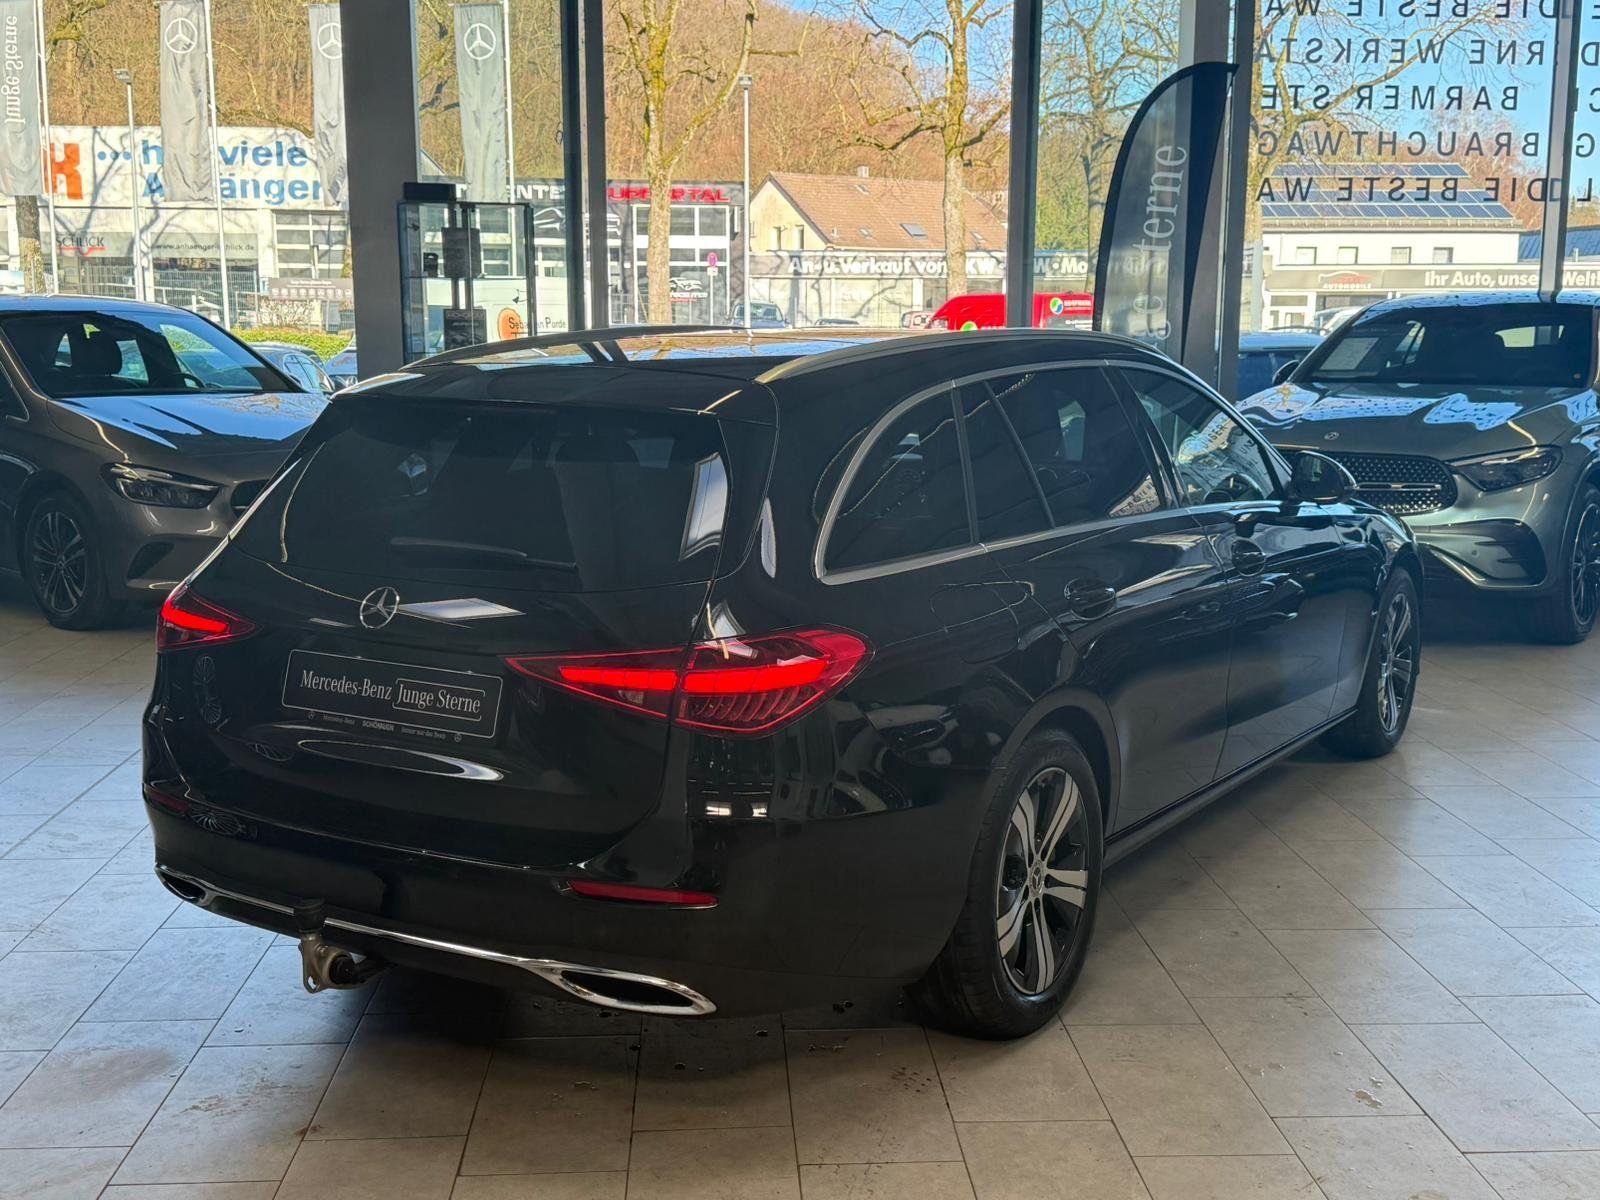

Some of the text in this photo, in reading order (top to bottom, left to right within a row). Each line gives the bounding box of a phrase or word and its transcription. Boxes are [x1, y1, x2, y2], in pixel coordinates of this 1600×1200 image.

[218, 140, 308, 166] viele
[917, 260, 947, 274] von
[1425, 271, 1448, 286] Ihr
[1450, 271, 1496, 289] Auto,
[1498, 274, 1539, 286] unse
[300, 669, 481, 714] Mercedes-Benz Junge Sterne
